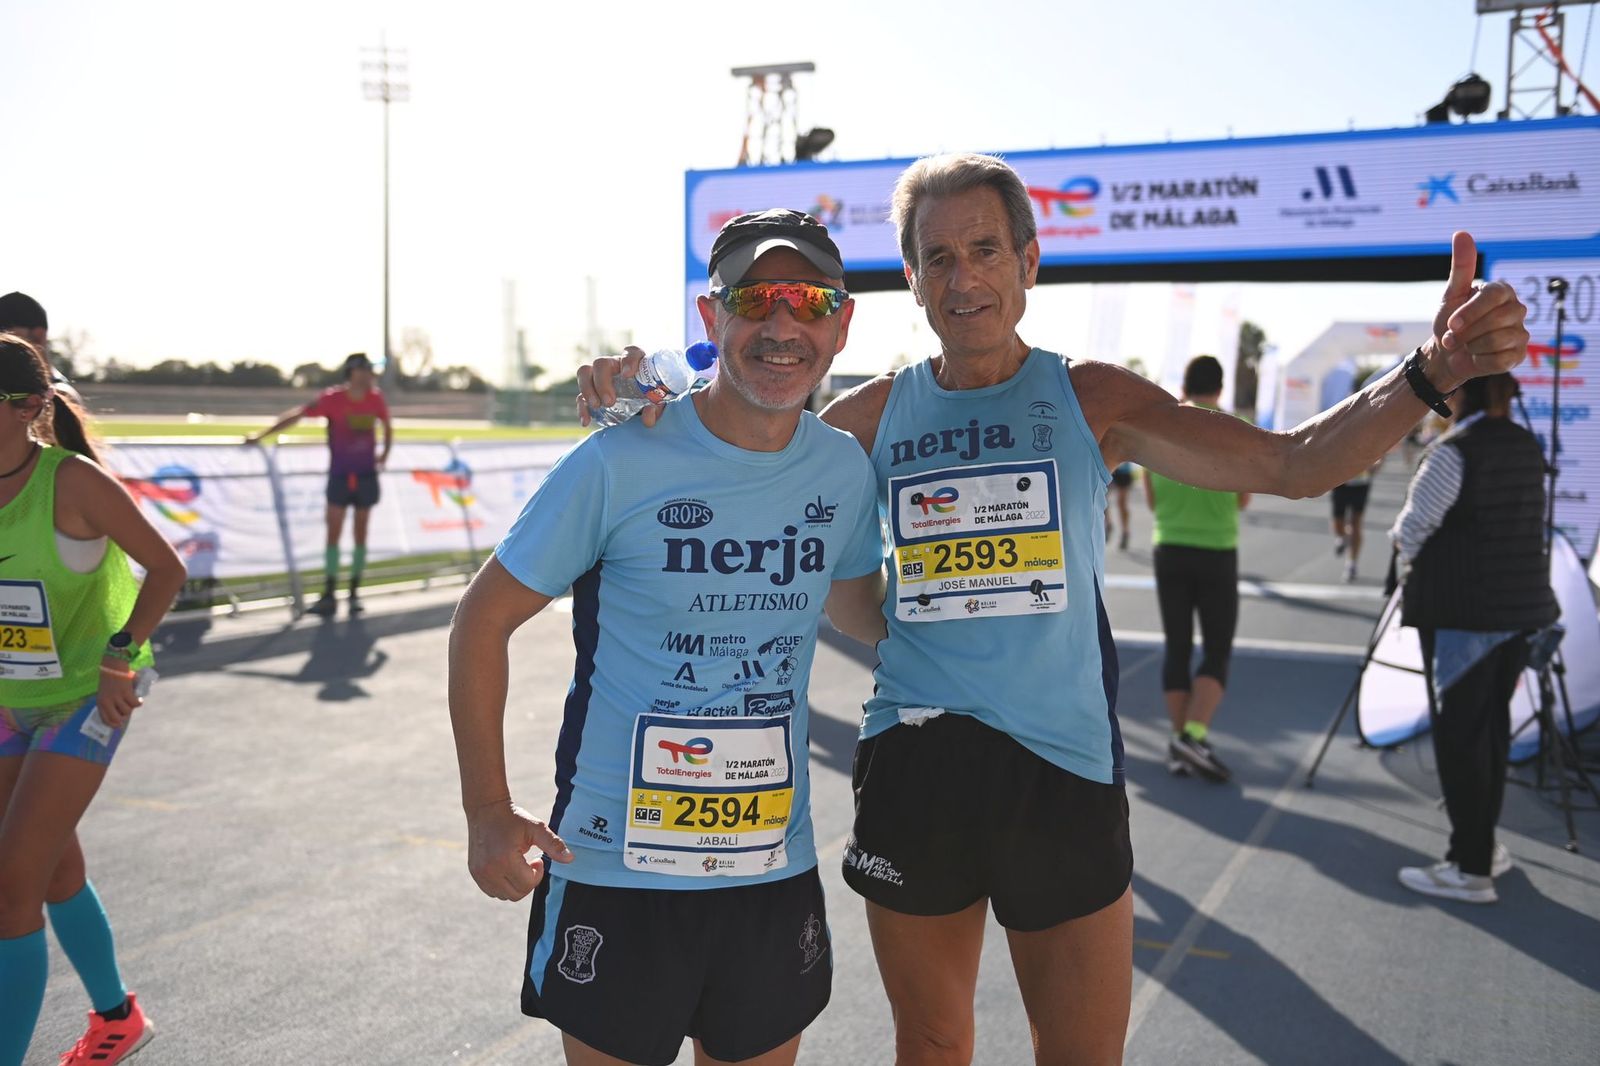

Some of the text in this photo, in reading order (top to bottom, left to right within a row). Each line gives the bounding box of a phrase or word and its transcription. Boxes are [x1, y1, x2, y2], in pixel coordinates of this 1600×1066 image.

[1111, 176, 1259, 202] 1/2 MARATÓN
[1466, 171, 1580, 194] CaixaBank
[1110, 207, 1238, 230] DE MÁLAGA
[890, 419, 1015, 467] nerja
[661, 505, 710, 524] TROPS
[974, 501, 1029, 514] 1/2 MARATÓN
[911, 517, 961, 529] TotalEnergies
[975, 510, 1046, 524] DE MÁLAGA 2022
[662, 525, 825, 586] nerja
[934, 537, 1018, 574] 2593
[1024, 557, 1058, 568] málaga
[938, 576, 1017, 591] JOSÉ MANUEL
[688, 592, 808, 613] ATLETISMO
[710, 634, 746, 645] metro
[709, 646, 749, 659] Málaga
[725, 758, 776, 769] 1/2 MARATÓN
[656, 767, 712, 779] TotalEnergies
[725, 766, 786, 780] DE MÁLAGA 2022
[674, 795, 761, 828] 2594
[764, 815, 788, 826] málaga
[697, 834, 738, 846] JABALÍ
